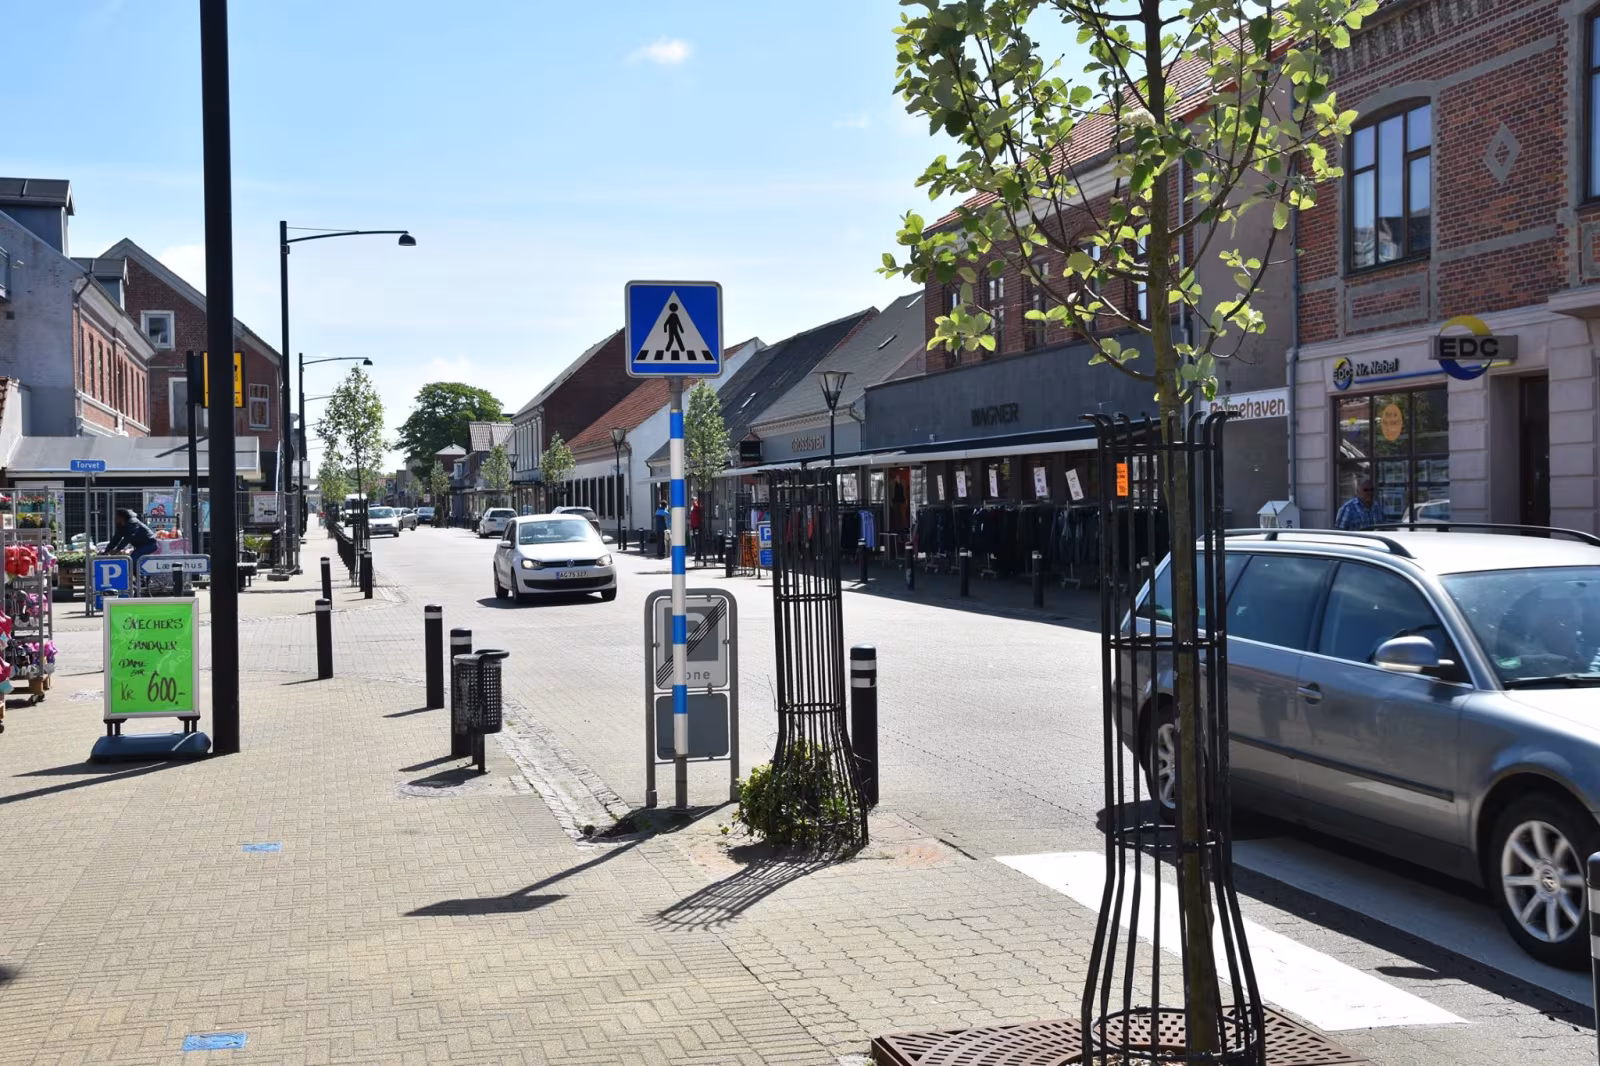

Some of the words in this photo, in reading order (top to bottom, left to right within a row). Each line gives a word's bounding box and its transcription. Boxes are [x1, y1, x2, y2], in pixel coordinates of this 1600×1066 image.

[1440, 338, 1499, 357] EDC
[1370, 357, 1400, 375] Nebel
[1333, 367, 1354, 380] EDC
[971, 402, 1019, 427] WAGNER
[76, 461, 100, 469] Torvet
[764, 527, 772, 540] P
[156, 561, 203, 570] Læhus
[100, 563, 122, 588] P
[123, 616, 184, 631] SKECHERS
[128, 640, 178, 654] SANDALER
